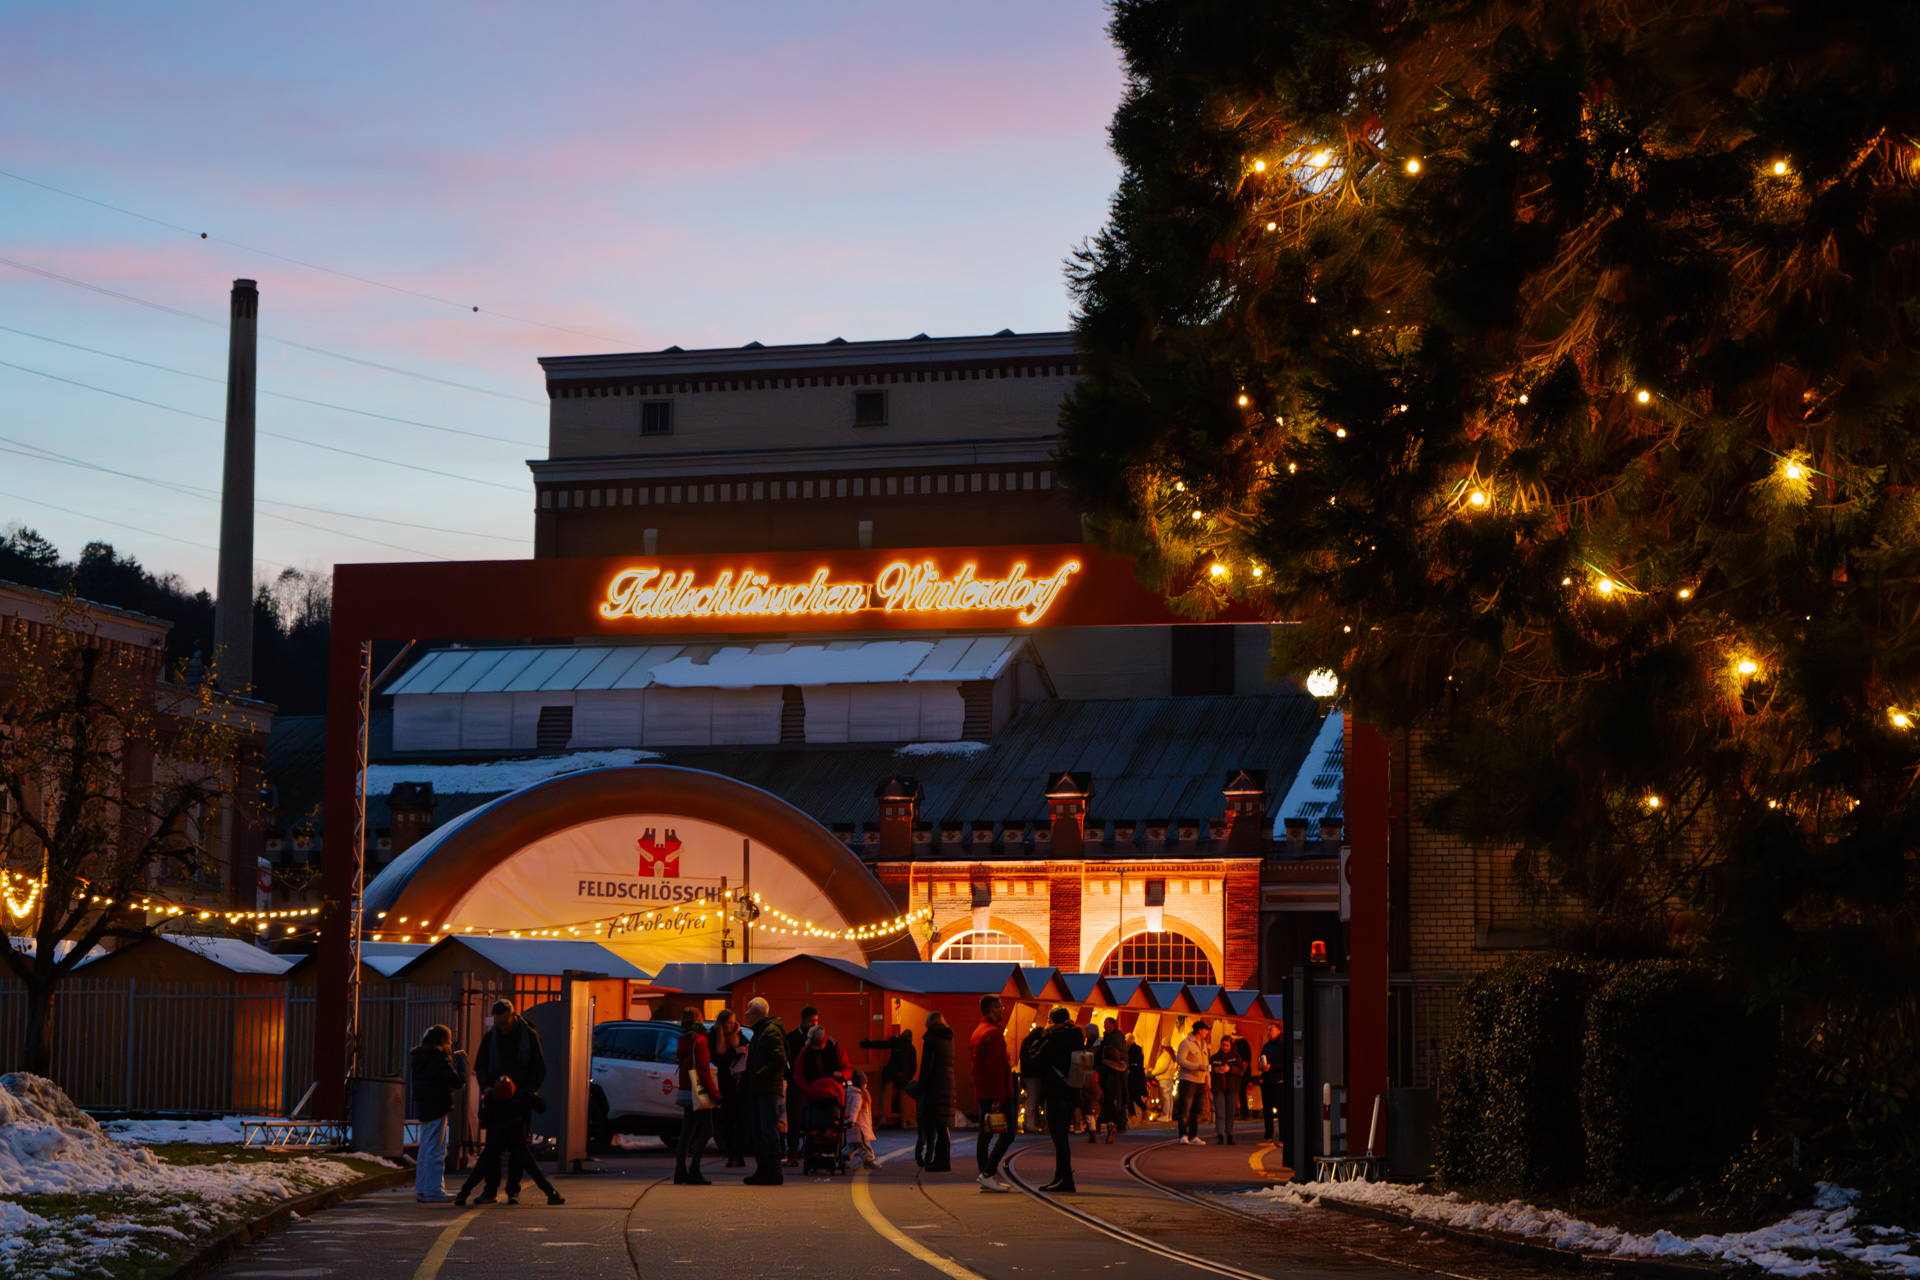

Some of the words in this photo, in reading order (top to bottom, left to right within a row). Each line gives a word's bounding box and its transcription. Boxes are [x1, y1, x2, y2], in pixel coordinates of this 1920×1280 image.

[600, 567, 866, 618] Feldschlösschen
[876, 560, 1080, 624] Winterdorf
[578, 880, 738, 903] FELDSCHLÖSSCH
[607, 912, 706, 939] Alkoholfrei
